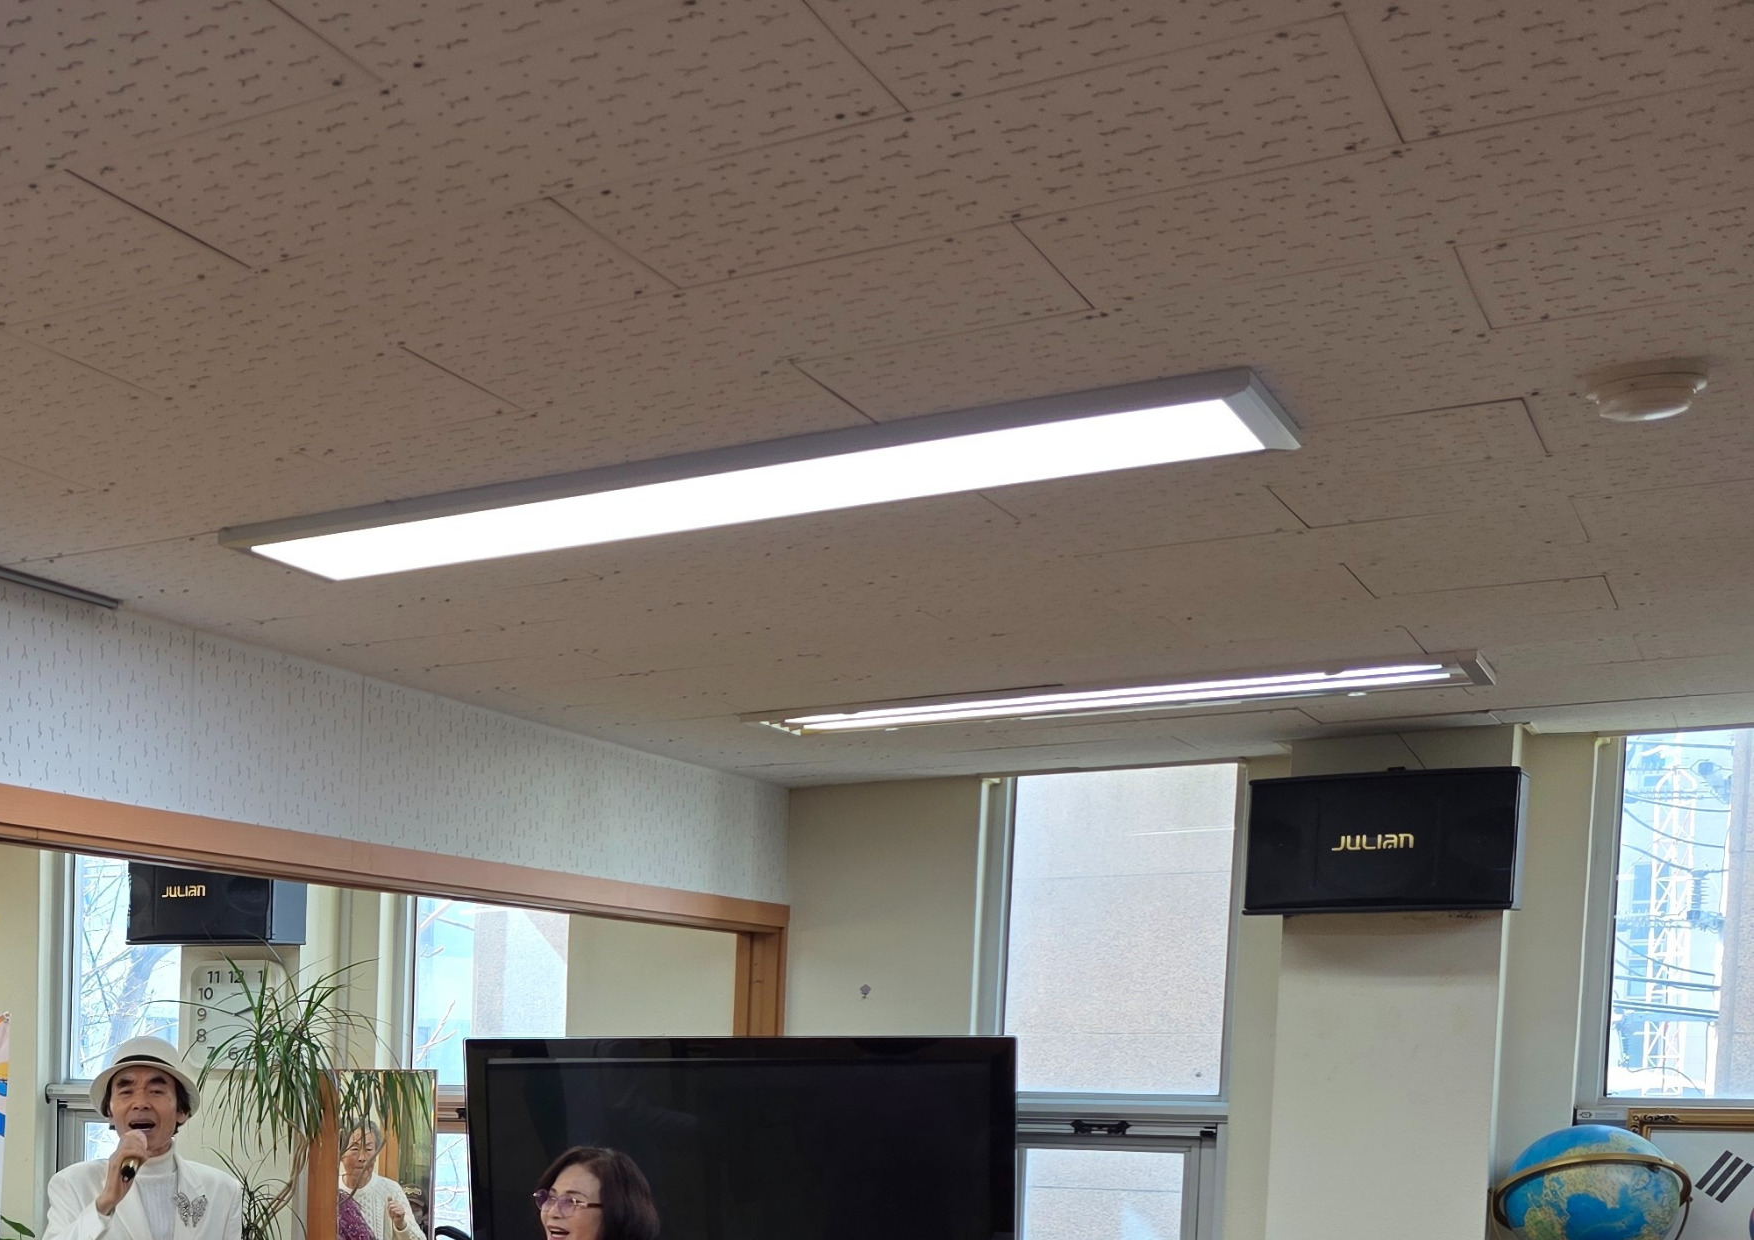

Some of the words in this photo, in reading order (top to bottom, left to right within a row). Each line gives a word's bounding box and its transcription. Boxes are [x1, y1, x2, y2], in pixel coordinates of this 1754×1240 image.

[207, 970, 221, 984] 11
[198, 987, 214, 1001] 10
[197, 1008, 207, 1021] 9
[196, 1028, 207, 1043] 8
